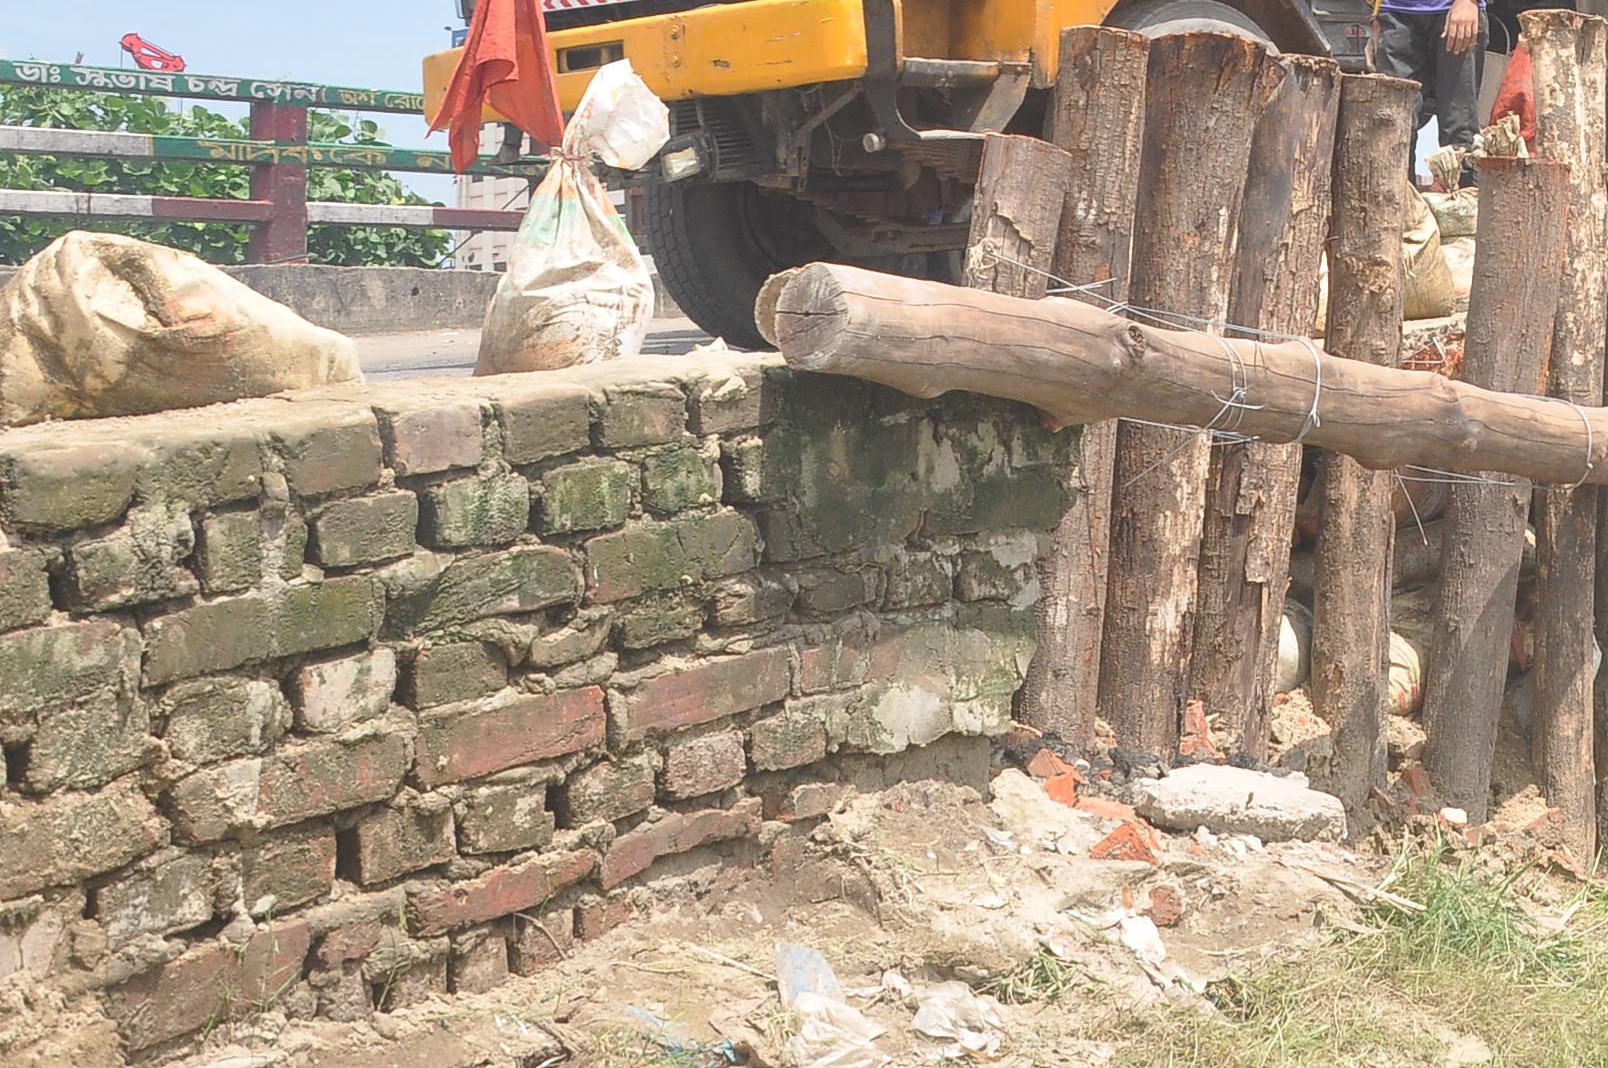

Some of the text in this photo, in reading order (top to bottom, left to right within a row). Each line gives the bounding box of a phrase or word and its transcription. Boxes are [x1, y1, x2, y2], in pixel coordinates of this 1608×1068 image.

[12, 61, 61, 83] ডাঃ
[184, 75, 241, 97] চন্দ্র
[250, 81, 320, 102] সেন
